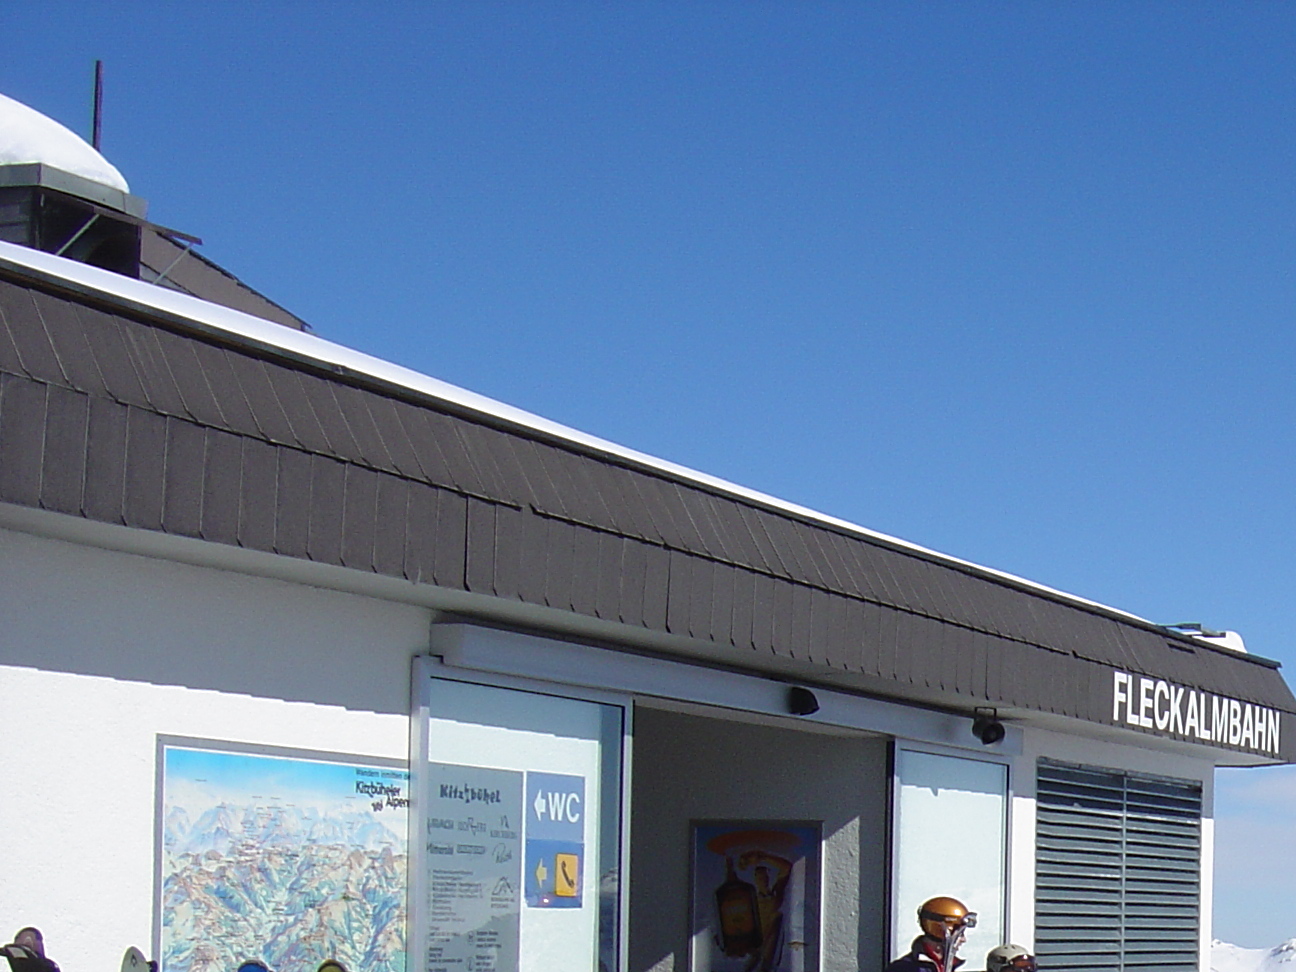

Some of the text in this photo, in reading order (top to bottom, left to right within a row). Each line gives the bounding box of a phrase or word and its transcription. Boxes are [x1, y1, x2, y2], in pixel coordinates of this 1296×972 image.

[1113, 670, 1280, 754] FLECKALMBAHN
[356, 781, 401, 797] Kitzbüheler
[440, 783, 501, 804] Kitzbühel
[548, 792, 580, 823] WC
